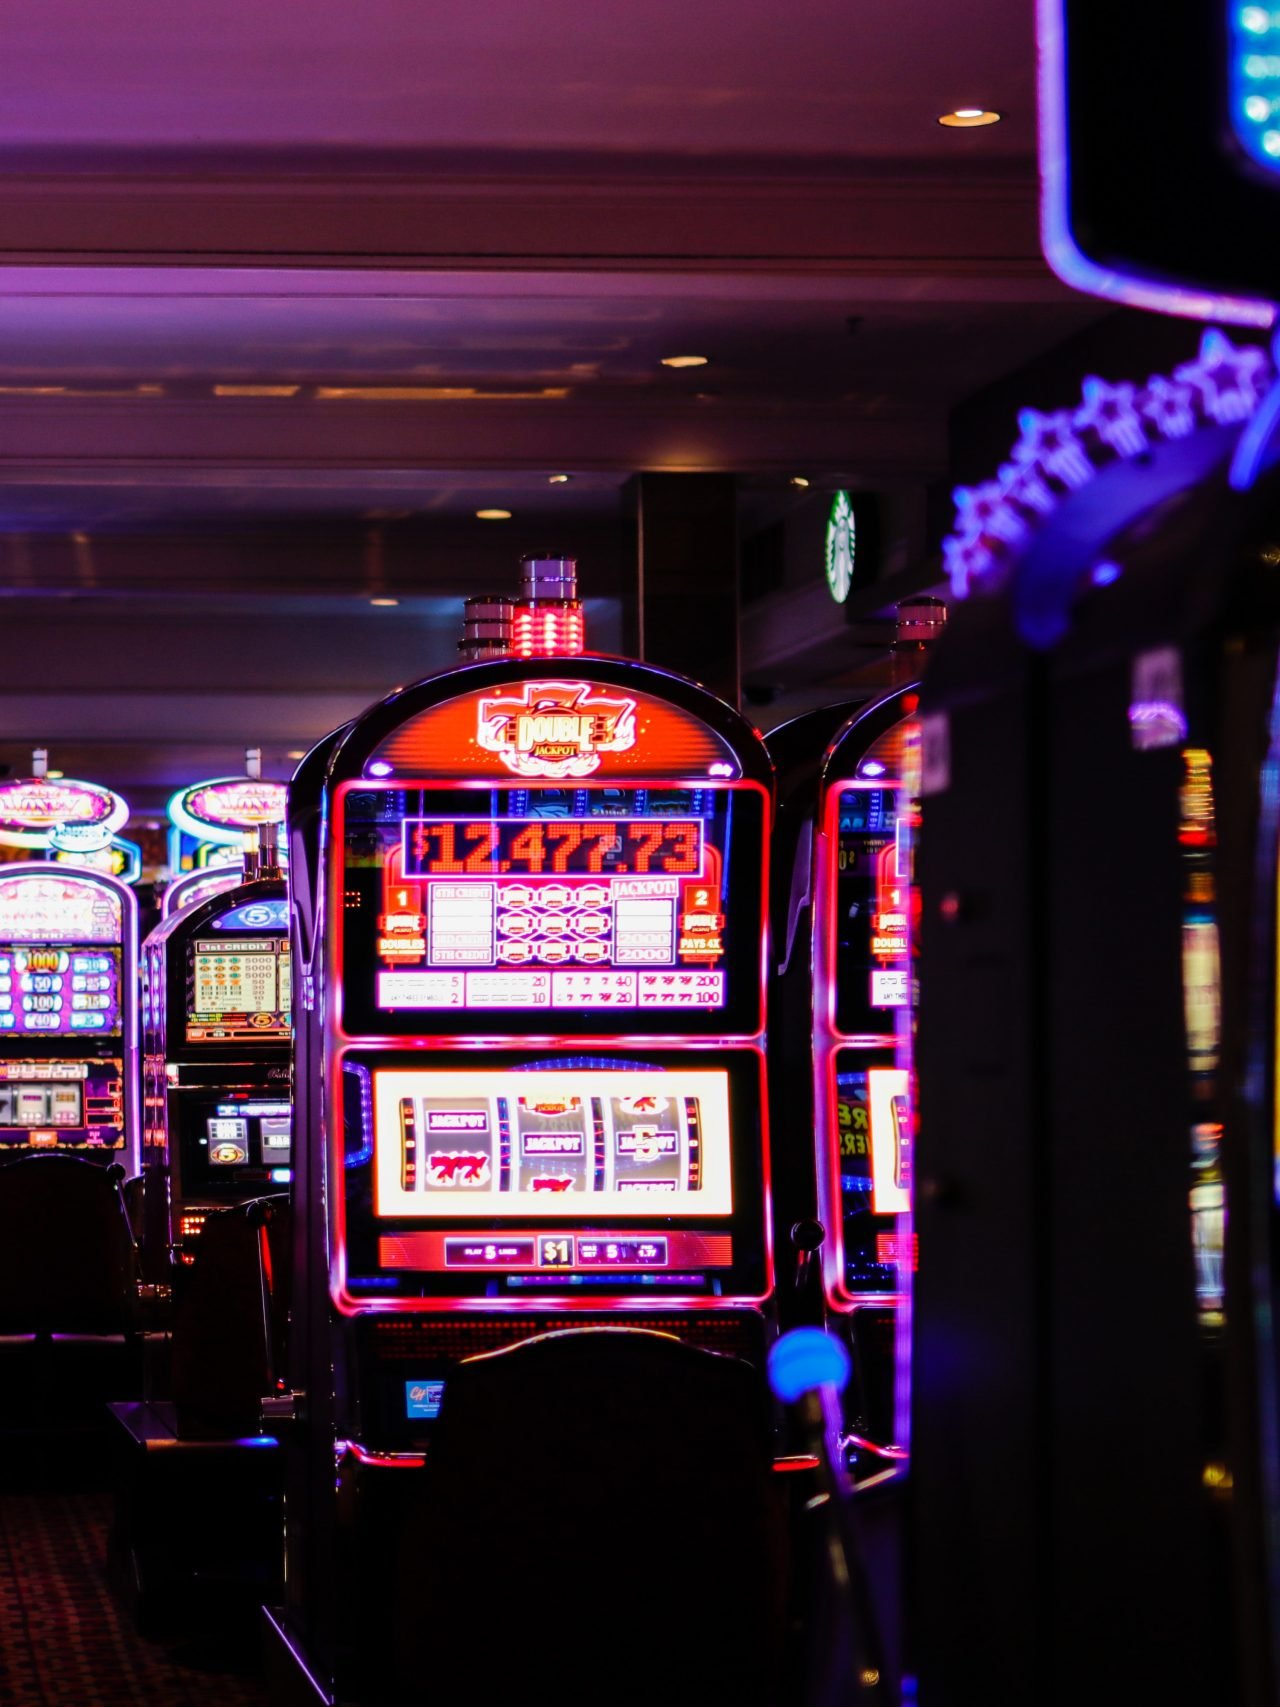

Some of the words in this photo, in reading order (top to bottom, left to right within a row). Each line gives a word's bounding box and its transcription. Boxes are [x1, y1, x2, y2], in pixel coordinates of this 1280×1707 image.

[519, 715, 595, 752] DOUBLE
[535, 745, 577, 756] JACKPOT
[412, 822, 699, 875] $12,477.73
[613, 880, 677, 898] JACKPOT!
[396, 890, 408, 907] 1
[694, 889, 709, 906] 2
[890, 889, 900, 905] 1
[248, 908, 267, 921] 5
[223, 943, 268, 951] CREDIT
[680, 937, 706, 949] PAYS
[706, 938, 721, 949] 4X
[455, 950, 489, 961] CREDIT
[619, 949, 669, 960] 2000
[26, 952, 59, 972] 1000
[34, 978, 51, 989] 50
[451, 976, 459, 988] 5
[532, 976, 546, 988] 20
[616, 976, 632, 987] 40
[696, 975, 720, 987] 200
[32, 996, 54, 1009] 100
[451, 992, 459, 1004] 2
[532, 992, 546, 1004] 10
[616, 992, 632, 1004] 20
[696, 991, 720, 1004] 100
[34, 1015, 51, 1026] 40
[254, 1014, 271, 1026] 5
[430, 1114, 486, 1129] JACKPOT
[525, 1136, 582, 1151] JACKPOT
[635, 1125, 659, 1161] 5
[484, 1245, 496, 1259] 5
[544, 1240, 568, 1262] $1
[606, 1245, 617, 1259] 5
